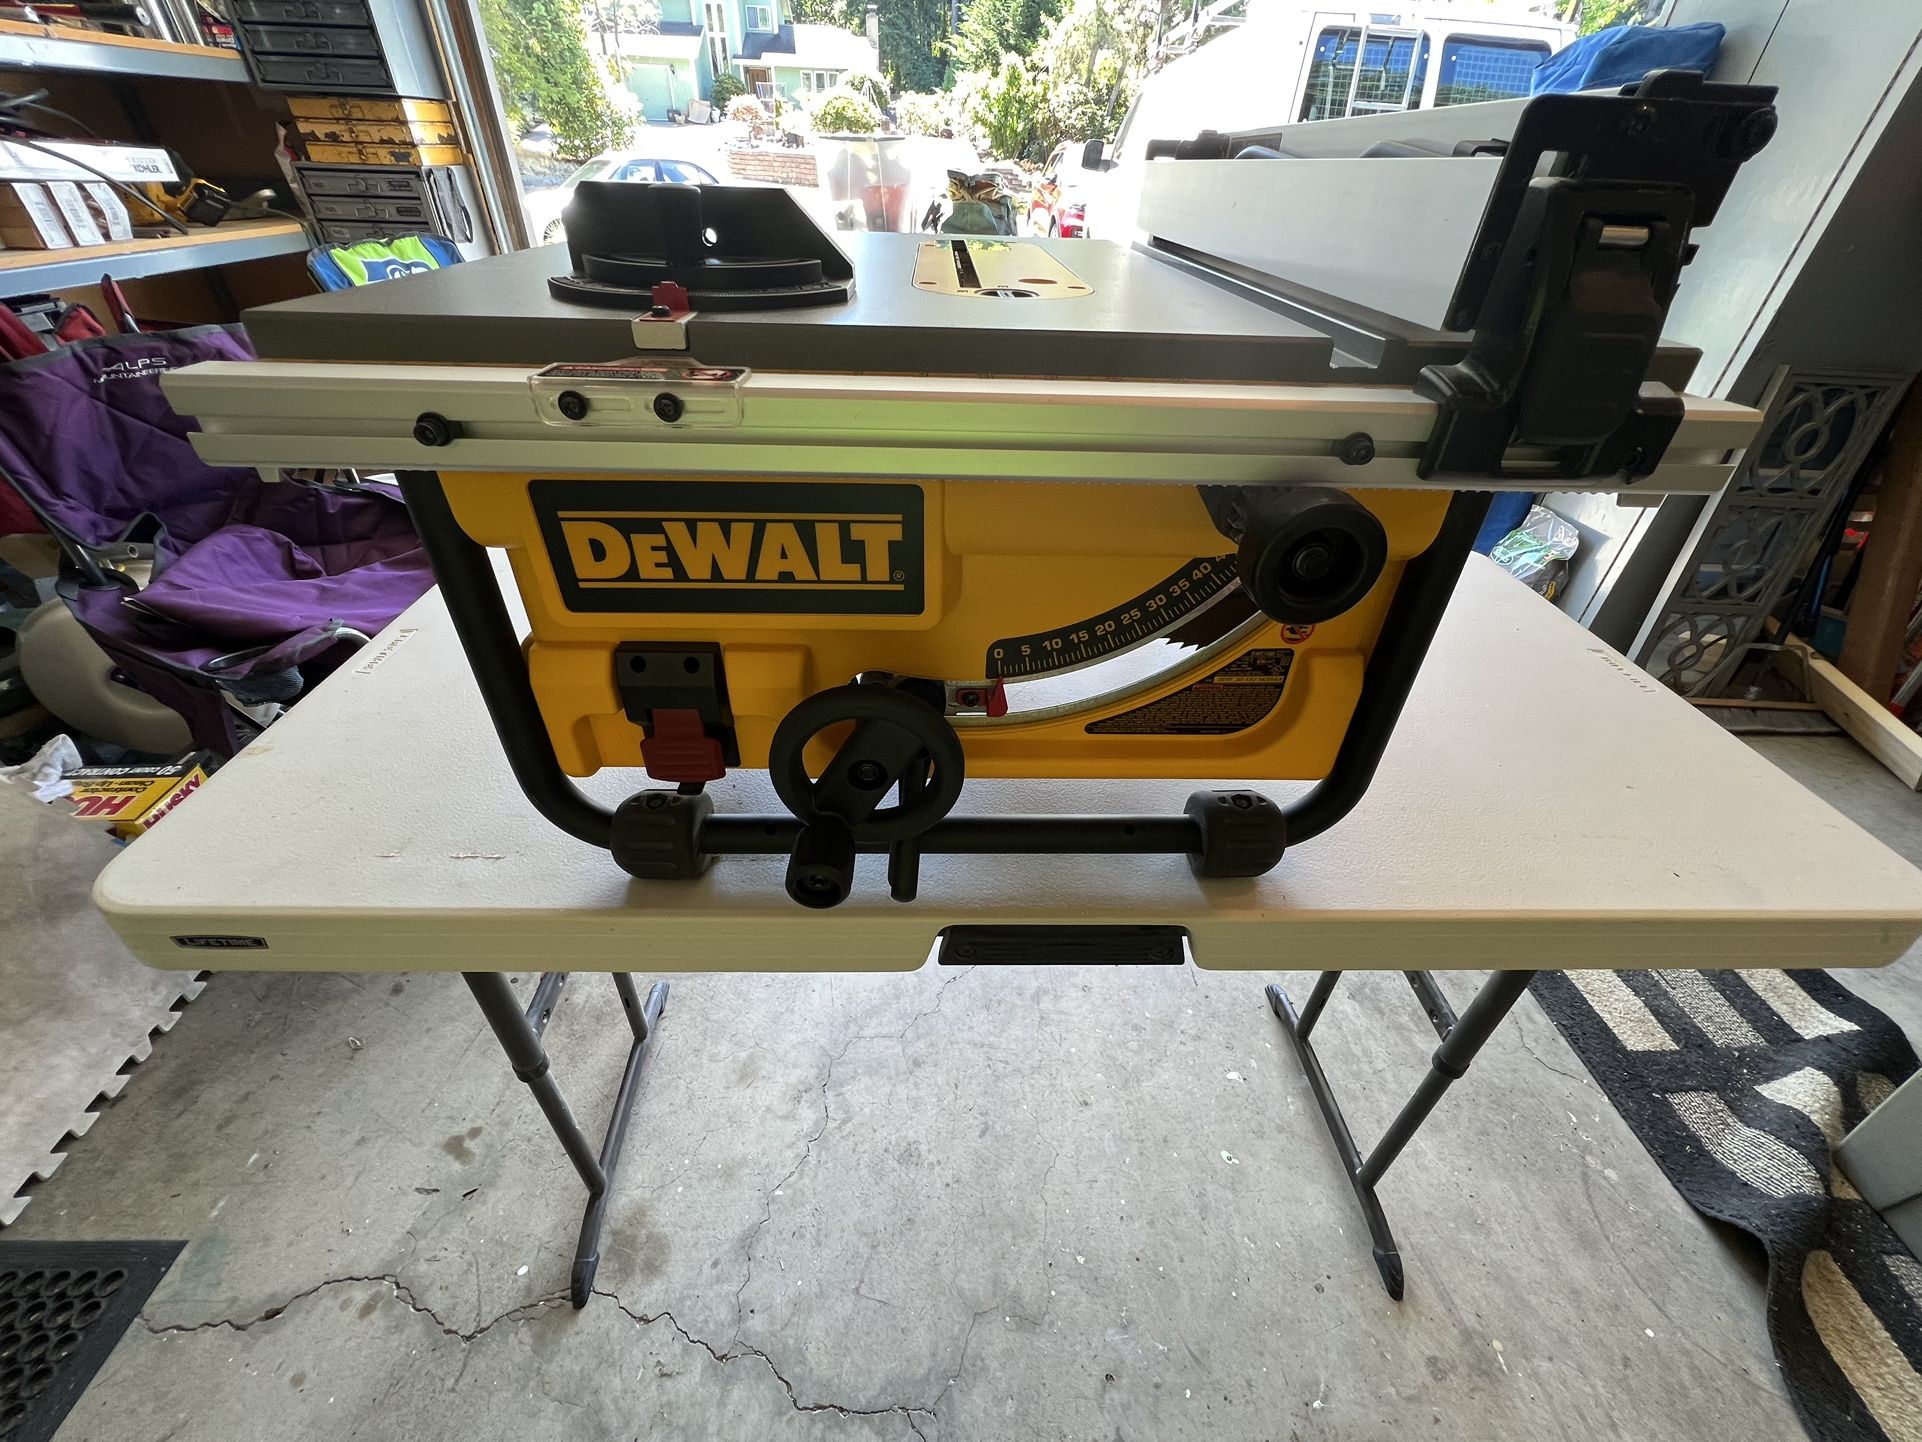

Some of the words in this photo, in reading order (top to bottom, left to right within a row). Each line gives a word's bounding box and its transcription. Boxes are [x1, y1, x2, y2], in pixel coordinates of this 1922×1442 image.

[102, 357, 167, 371] ALPS
[559, 520, 903, 582] DEWALT
[993, 648, 1004, 660] 0
[1020, 644, 1031, 656] 5
[1042, 637, 1063, 651] 10
[1068, 630, 1090, 645] 15
[1094, 619, 1116, 636] 20
[1120, 607, 1142, 625] 25
[1145, 593, 1168, 612] 30
[1168, 577, 1191, 598] 35
[1191, 561, 1213, 582] 40
